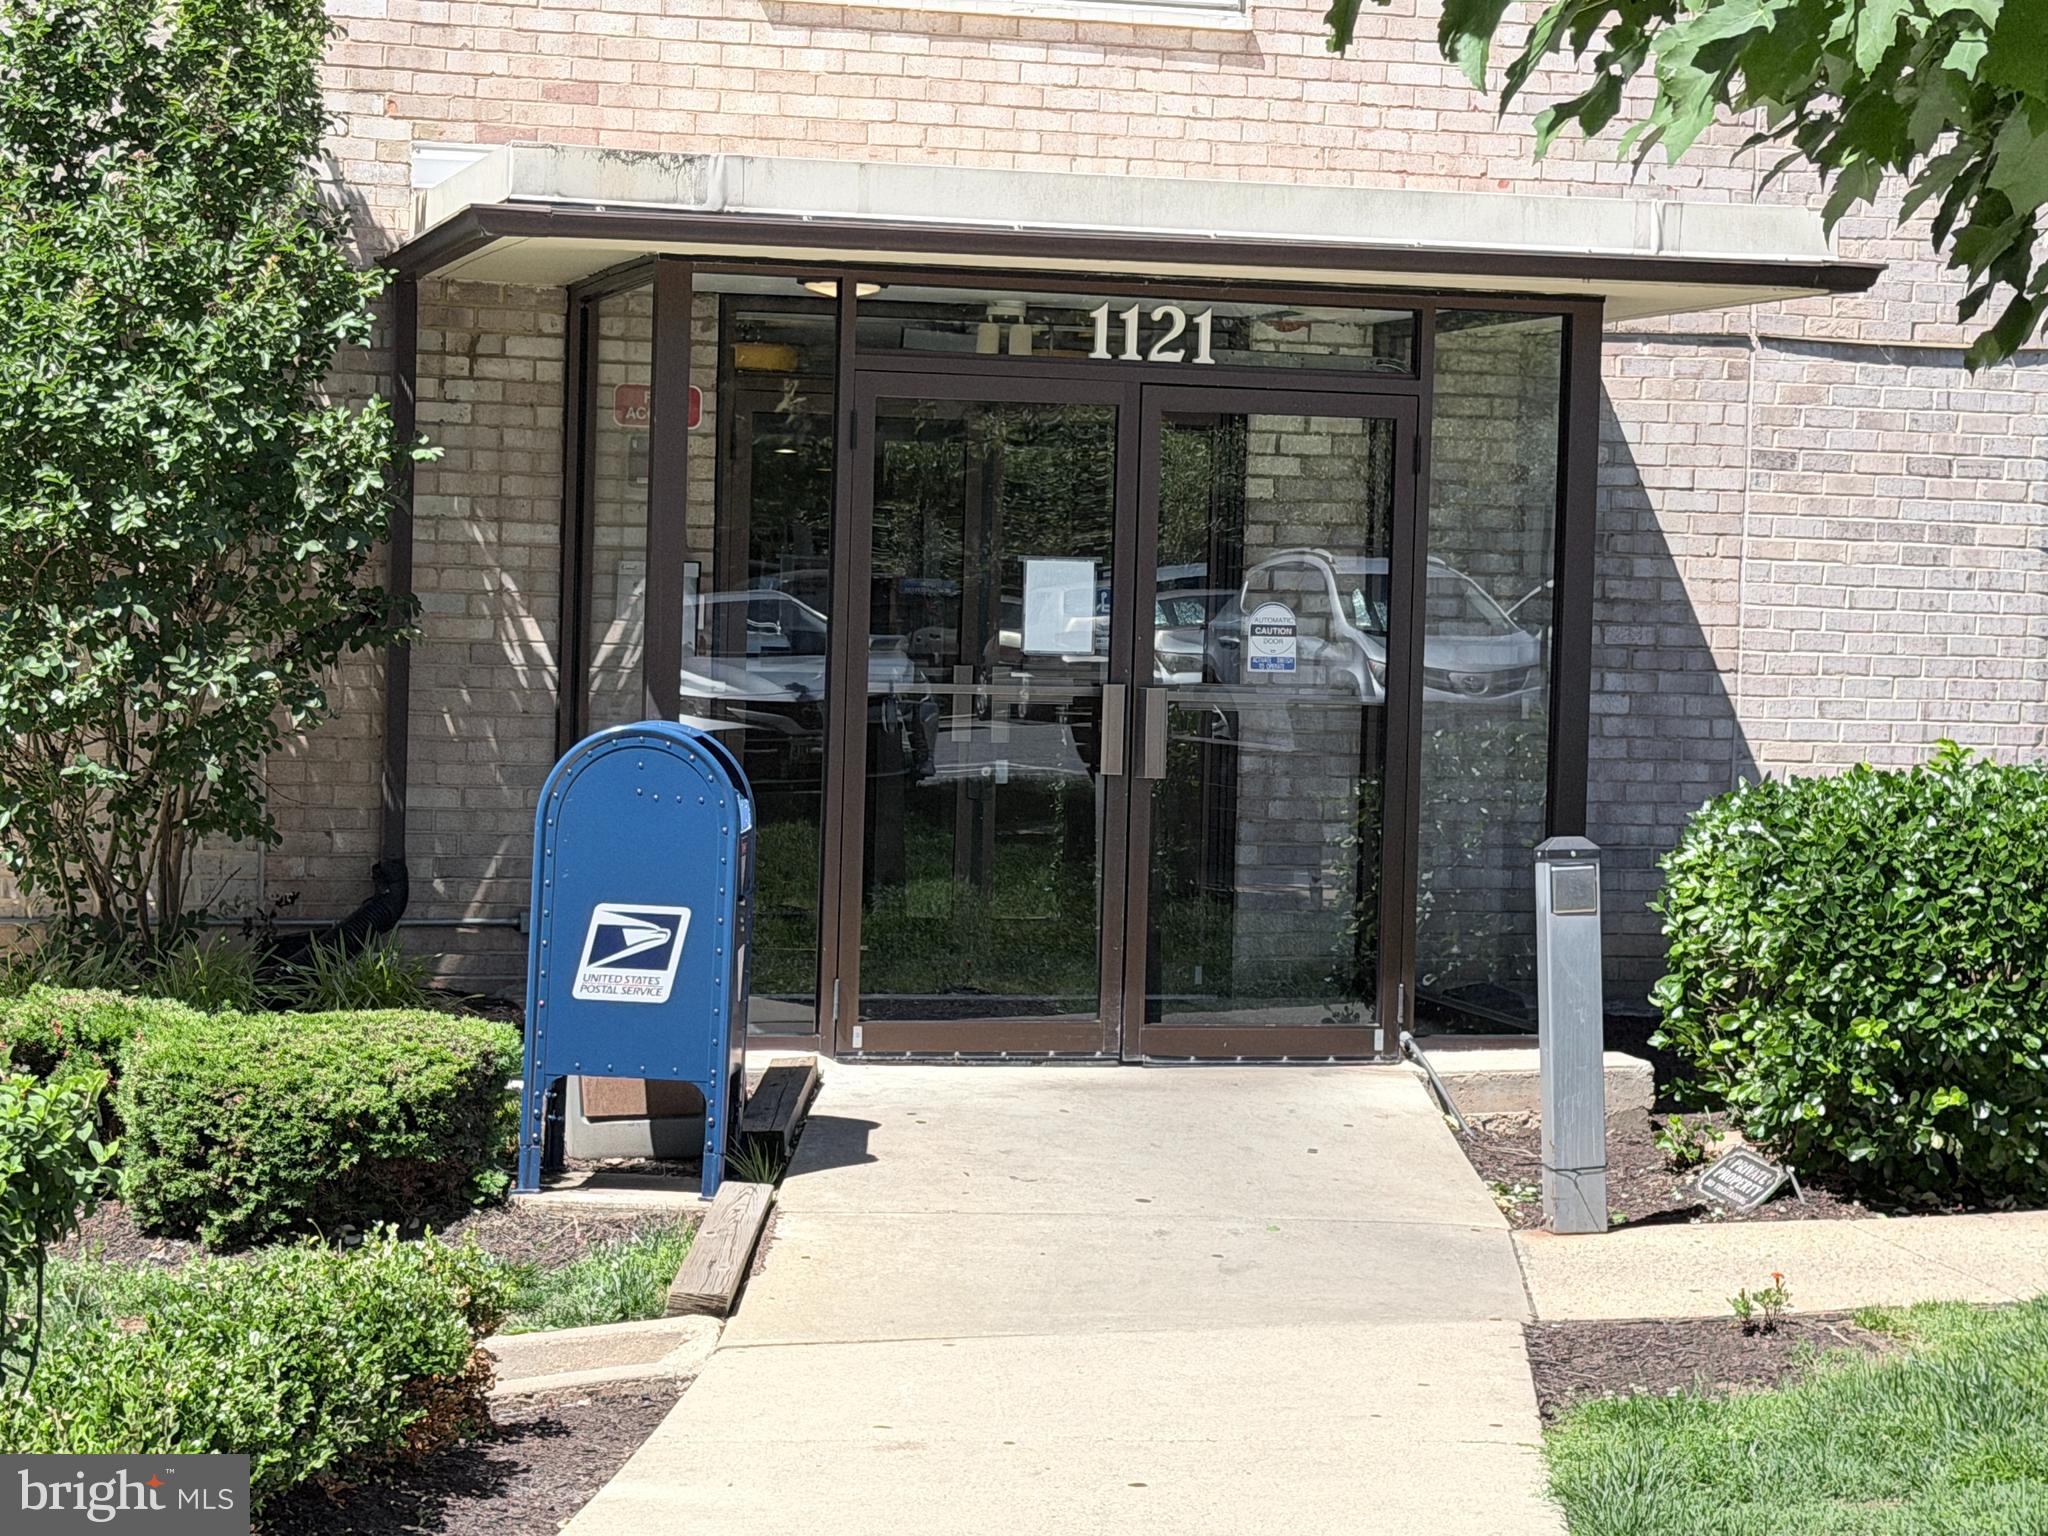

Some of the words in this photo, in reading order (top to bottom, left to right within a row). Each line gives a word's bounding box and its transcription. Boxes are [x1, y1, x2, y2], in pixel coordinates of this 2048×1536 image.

[1088, 301, 1216, 365] 1121
[1254, 626, 1293, 635] CAUTION
[583, 973, 622, 984] UNITED
[624, 975, 661, 985] STATES
[579, 984, 618, 995] POSTAL
[621, 985, 664, 997] SERVICE
[1729, 1158, 1772, 1185] PRIVATE
[1712, 1166, 1764, 1198] PROPERTY
